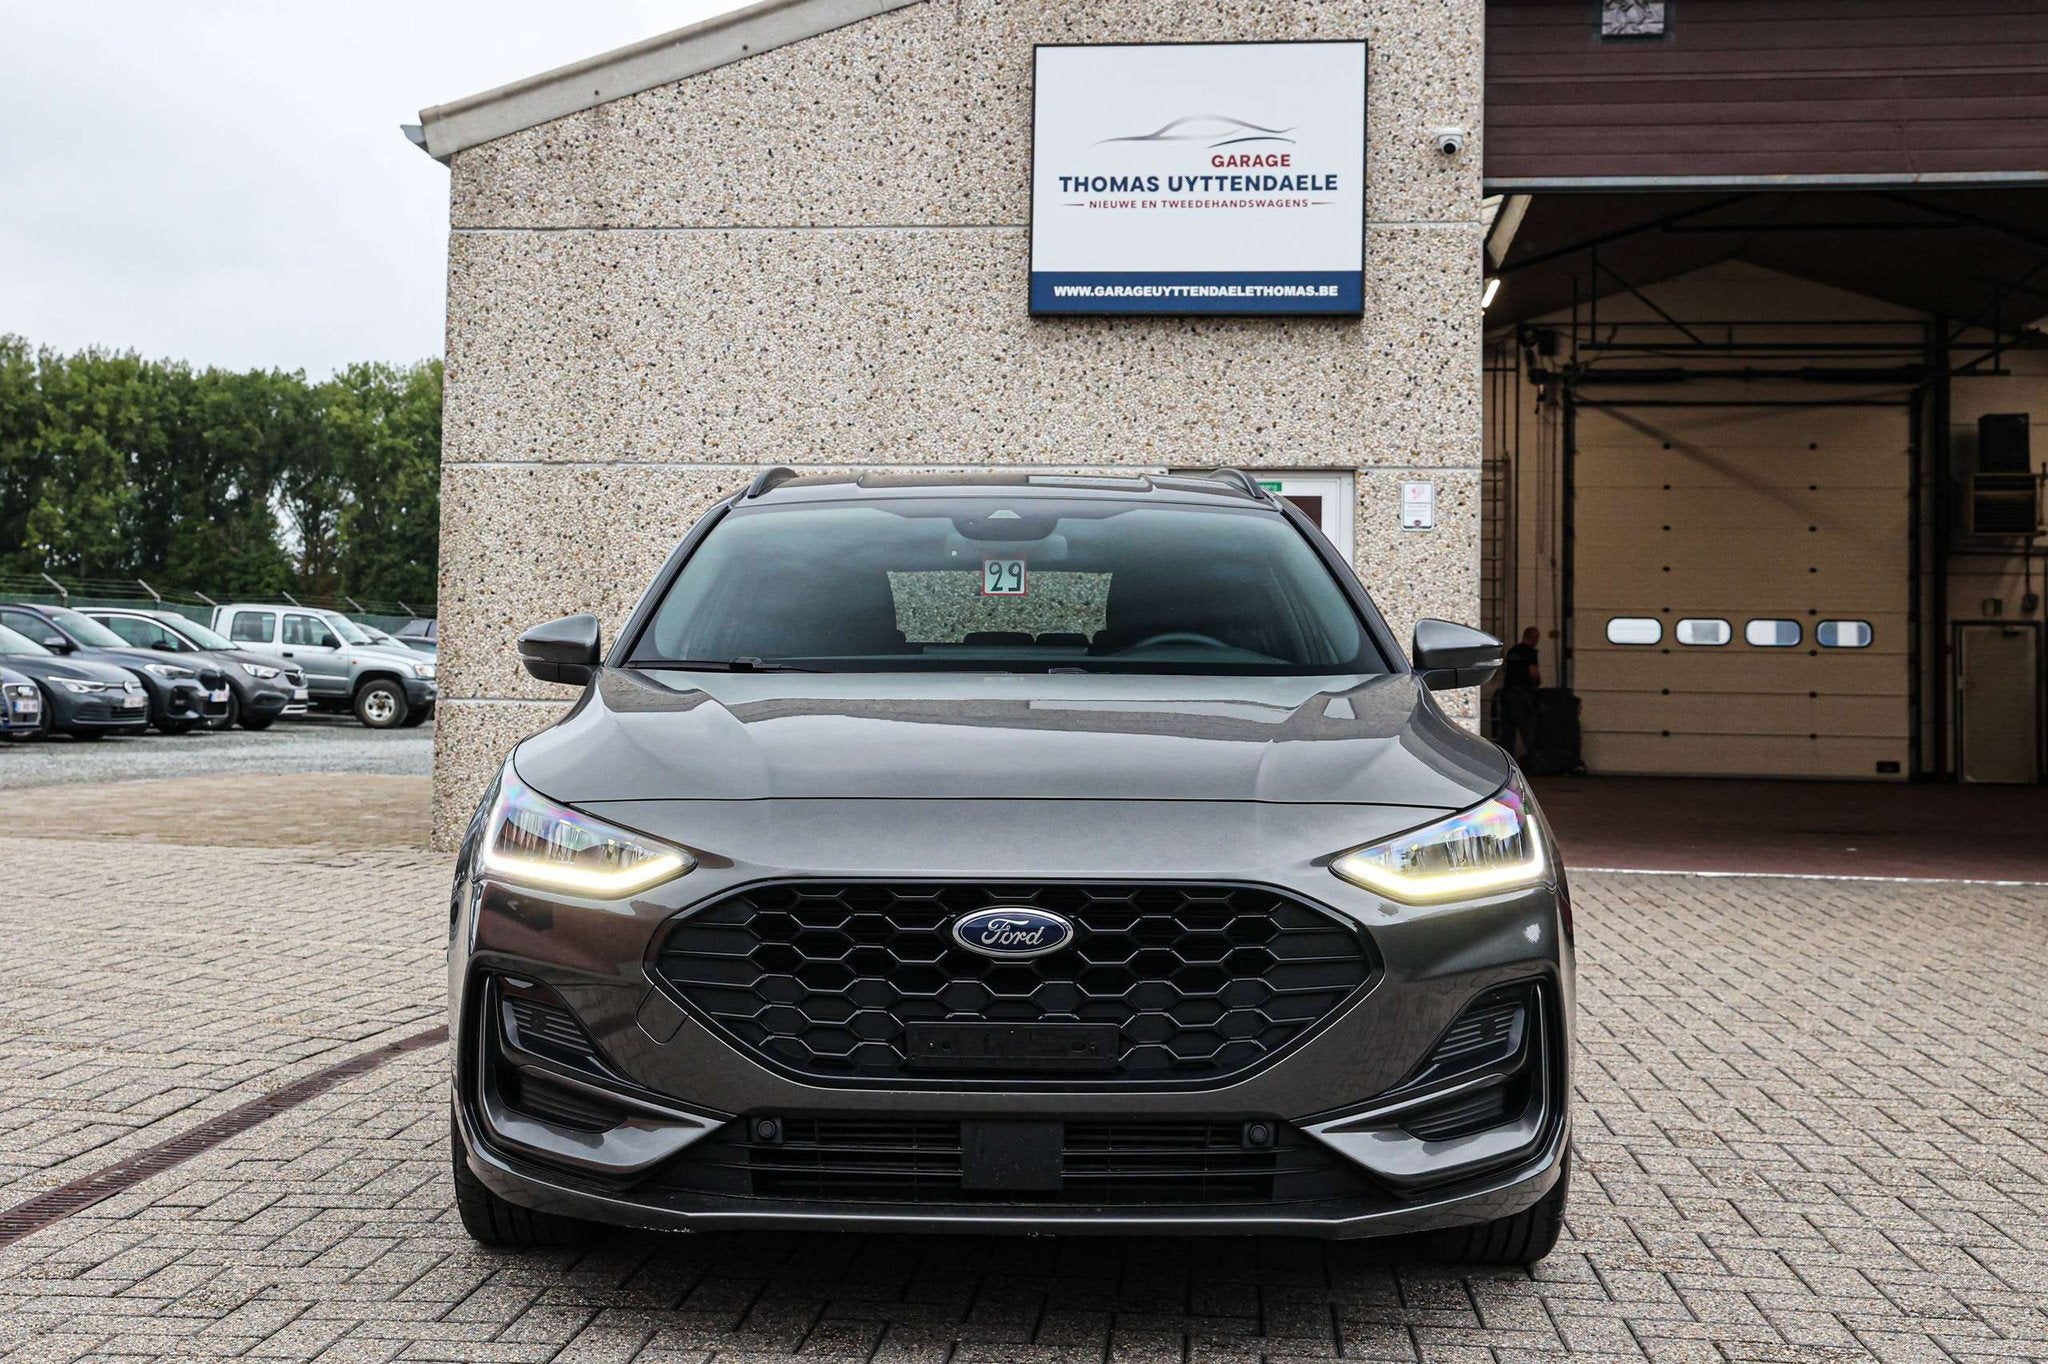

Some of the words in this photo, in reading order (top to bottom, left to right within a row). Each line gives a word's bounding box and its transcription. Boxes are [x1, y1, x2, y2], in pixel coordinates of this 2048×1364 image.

[1211, 154, 1291, 168] GARAGE
[1058, 175, 1160, 193] THOMAS
[1167, 174, 1338, 192] UYTTENDAELE
[1088, 200, 1137, 209] NIEUWE
[1141, 200, 1158, 209] EN
[1161, 199, 1309, 209] TWEEDEHANDSWAGENS
[1053, 285, 1339, 297] WWW.GARAGEUYTTENDAELETHOMAS.BE
[981, 918, 1045, 945] Ford
